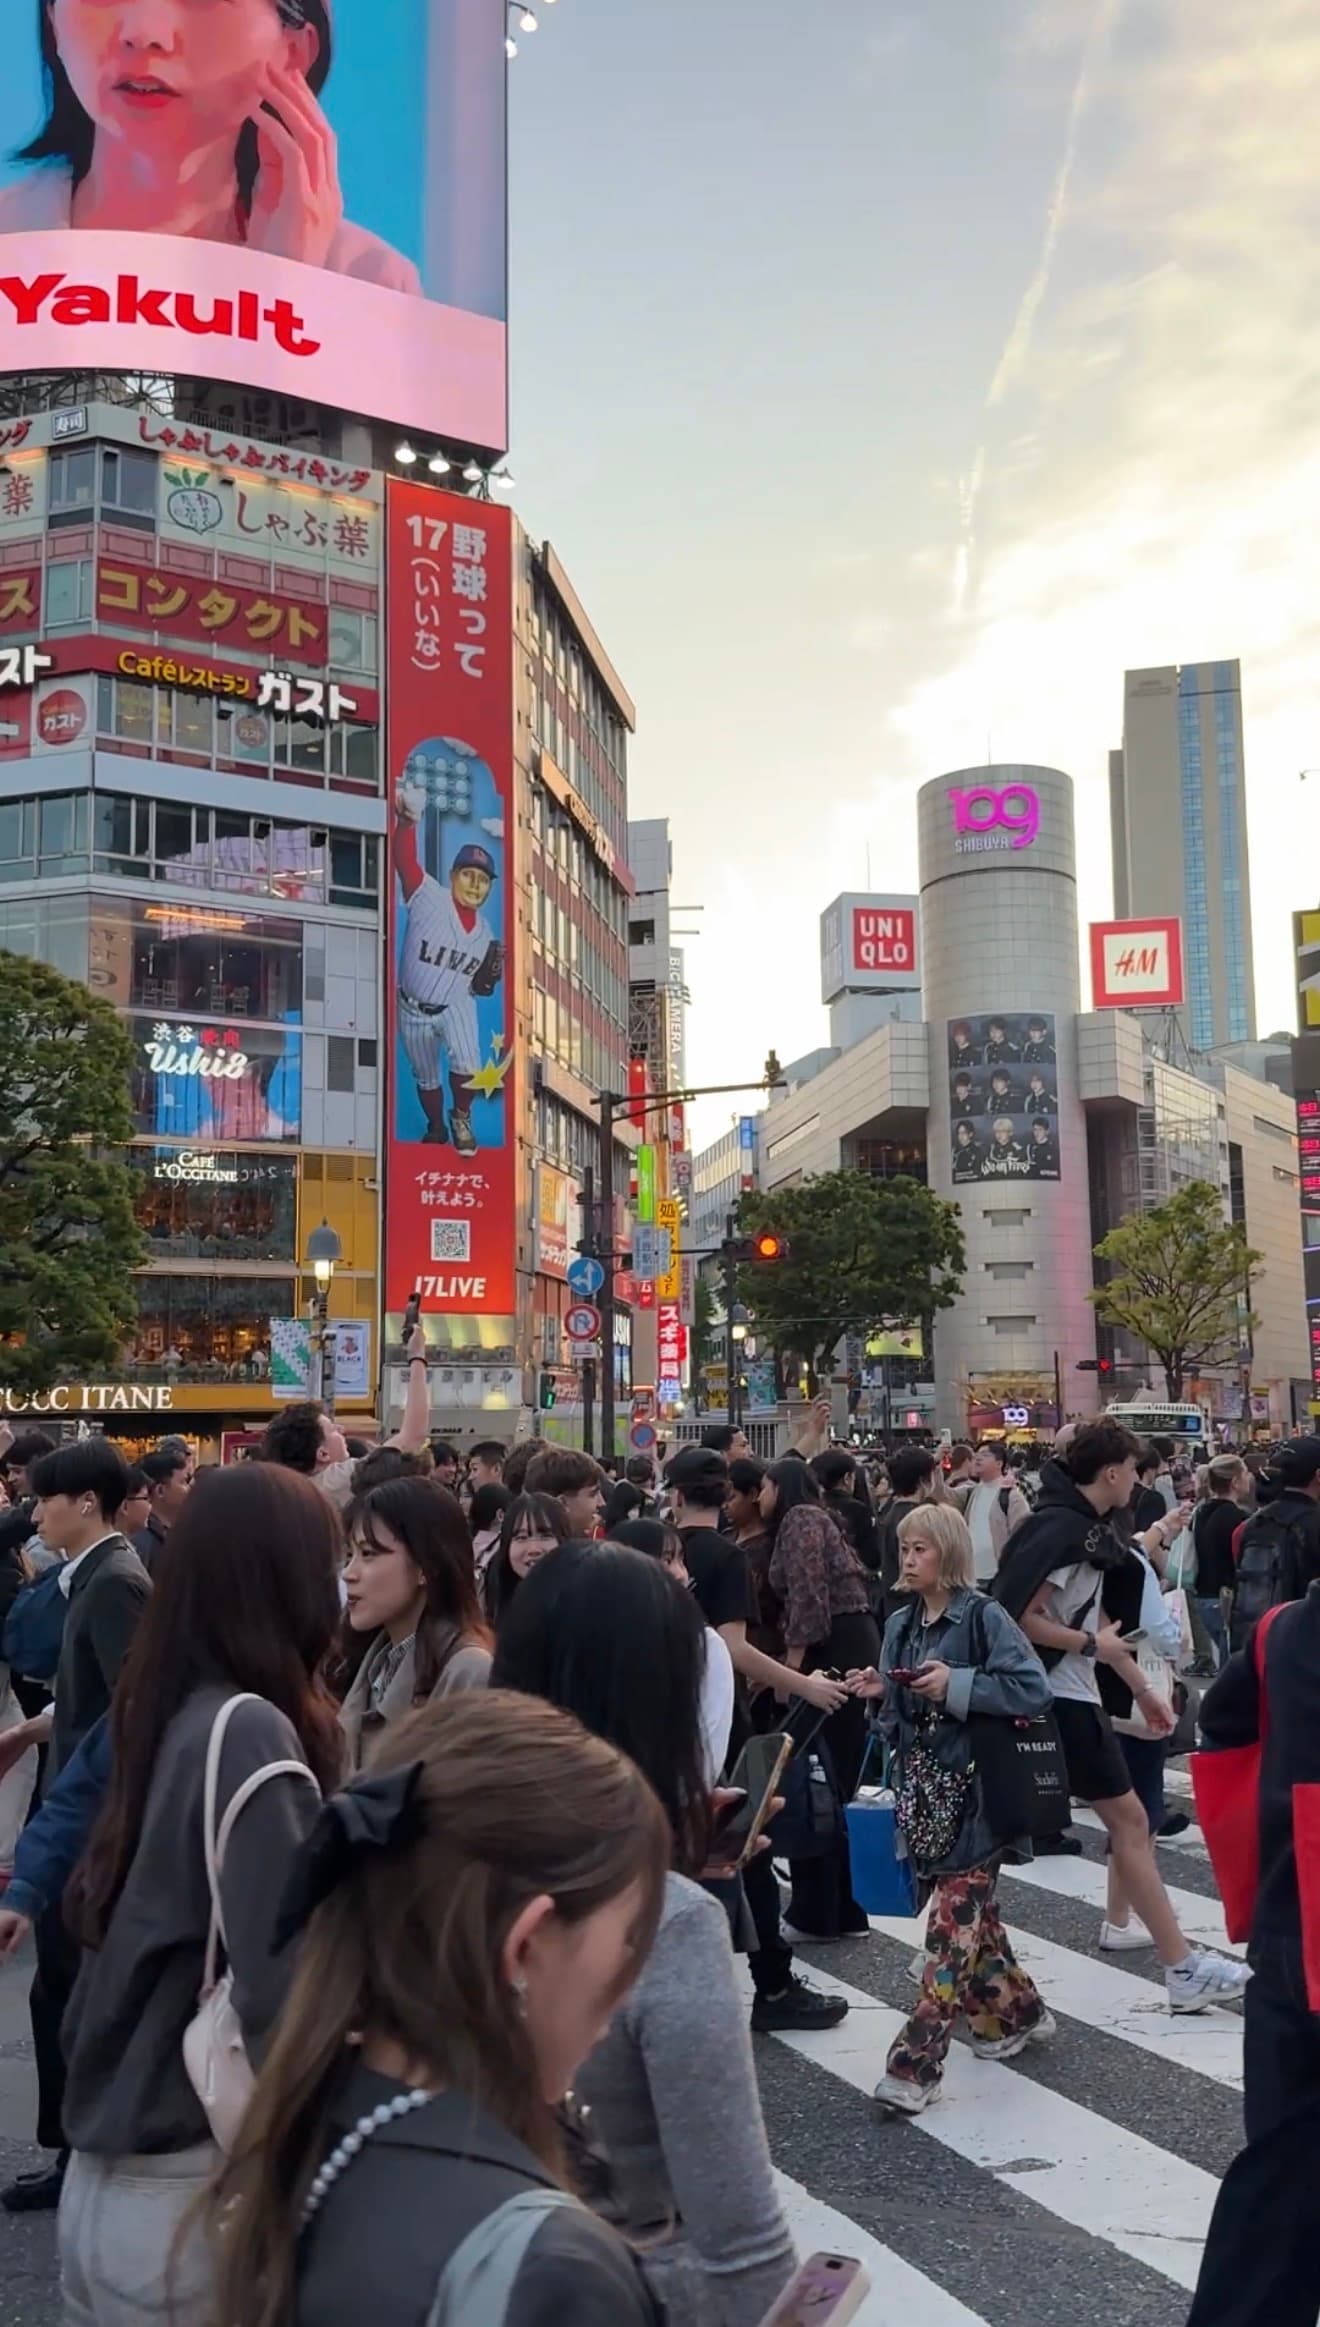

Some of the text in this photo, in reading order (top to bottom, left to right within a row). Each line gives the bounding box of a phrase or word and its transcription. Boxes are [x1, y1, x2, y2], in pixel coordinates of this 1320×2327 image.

[0, 273, 320, 356] Yakult
[138, 416, 371, 492] しゃぶしゃぶバイキング
[237, 491, 369, 558] しゃぶ葉
[100, 569, 320, 647] コンタクト
[451, 522, 487, 678] 野球って
[257, 671, 358, 720] ガスト
[947, 782, 1041, 849] 109
[954, 836, 1009, 853] SHIBUYA
[859, 915, 904, 939] UNI
[418, 939, 481, 976] LIVE
[859, 940, 908, 967] QLO
[414, 1171, 491, 1190] イチナナで、
[414, 1275, 487, 1299] 17LIVE
